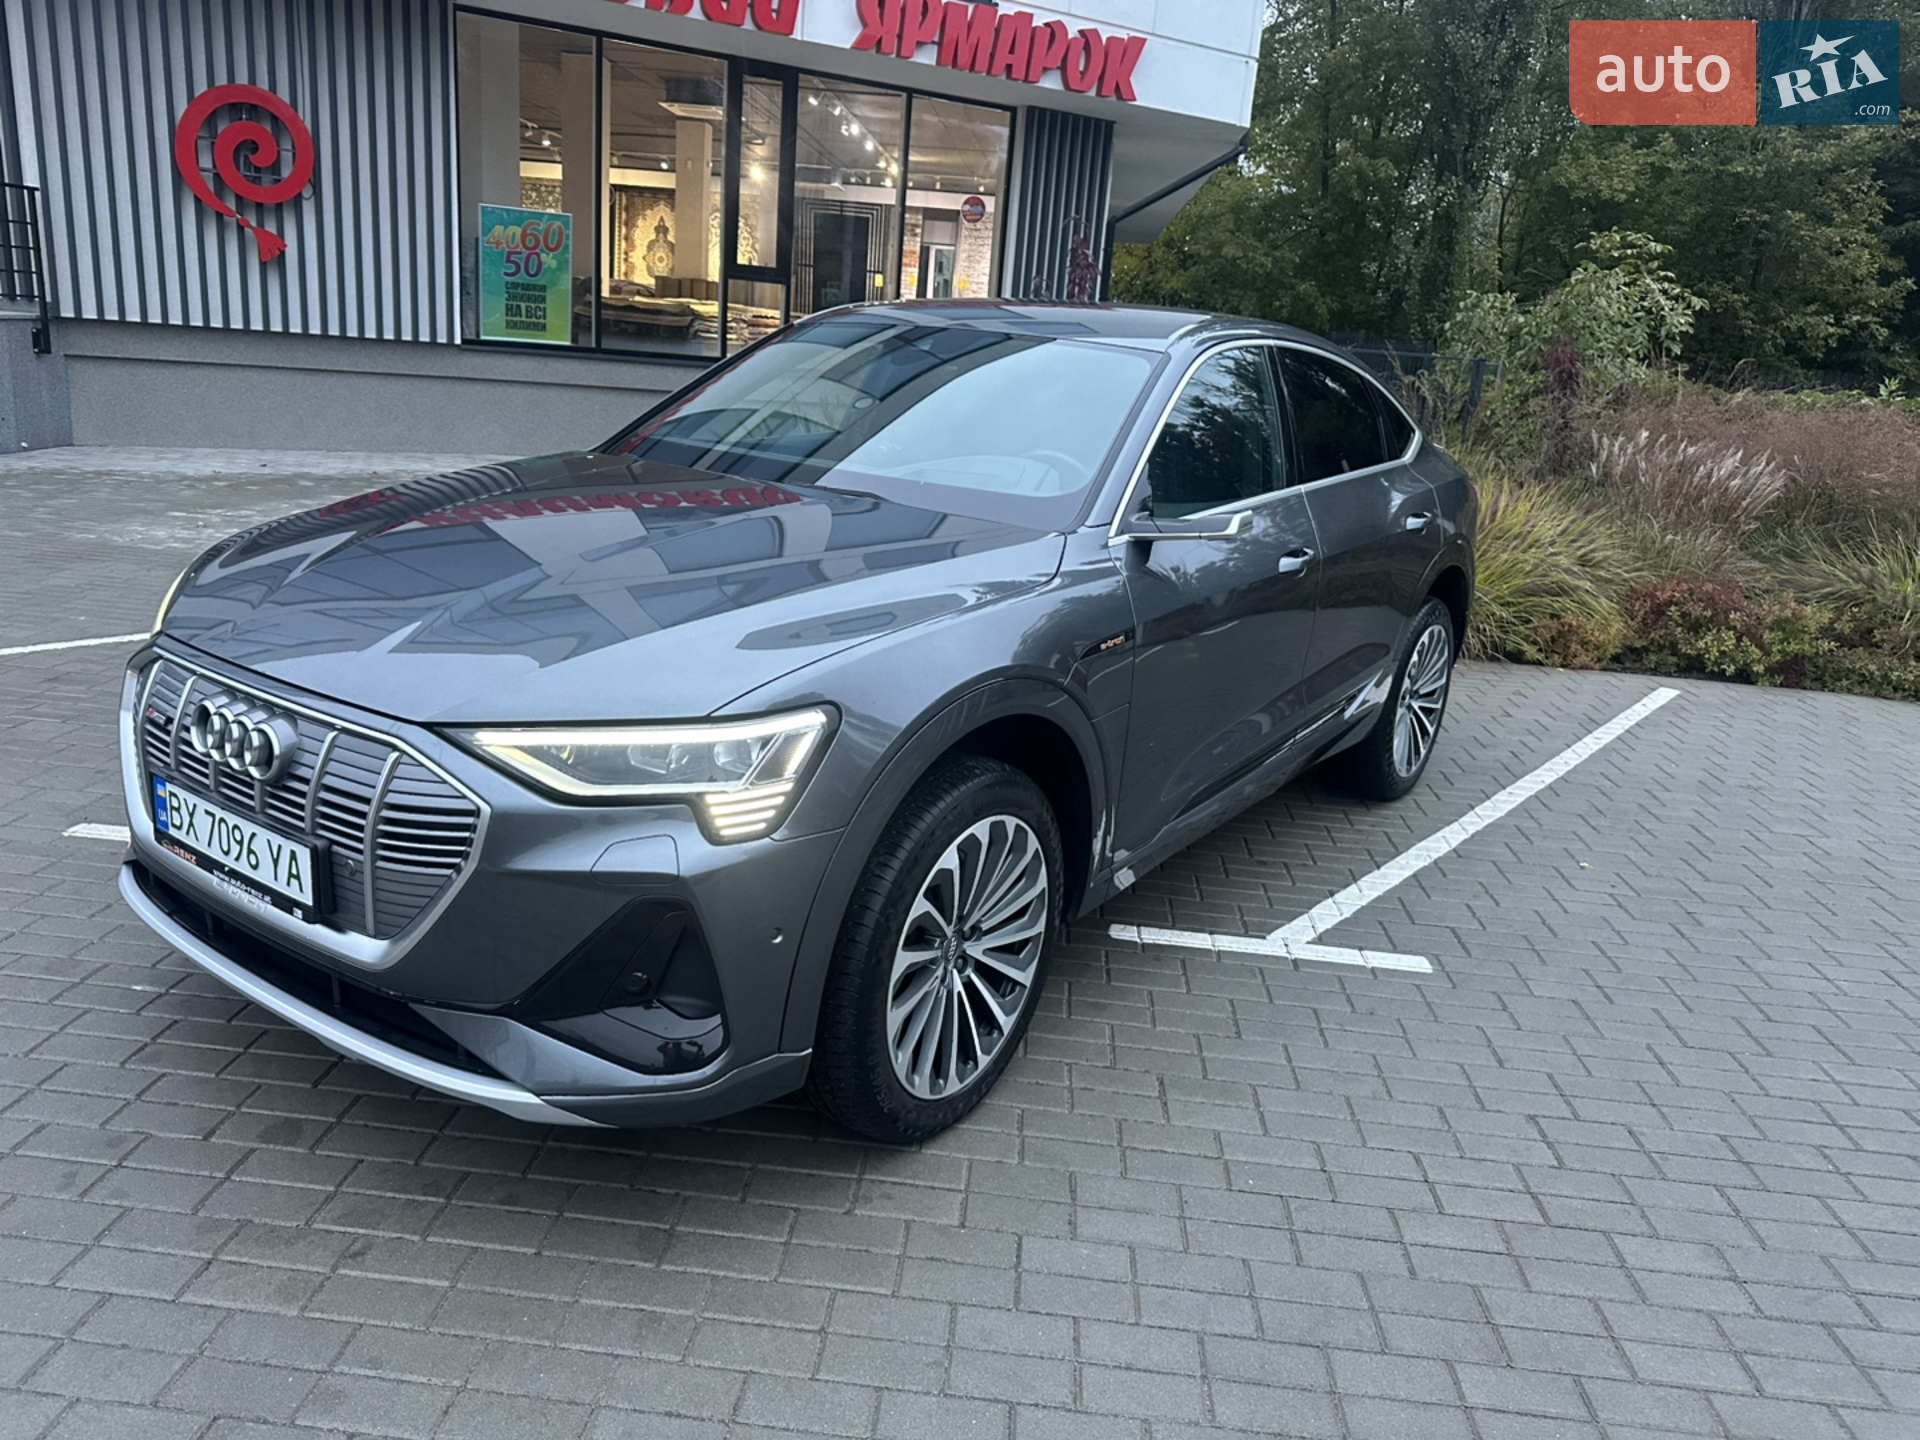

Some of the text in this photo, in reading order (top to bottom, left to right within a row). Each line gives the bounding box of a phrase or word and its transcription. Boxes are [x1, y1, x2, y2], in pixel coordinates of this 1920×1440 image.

[851, 0, 1148, 101] ЯРМАРОК
[520, 220, 565, 253] 60
[505, 303, 547, 320] НА ВСІ
[168, 790, 304, 894] BX 7096 YA
